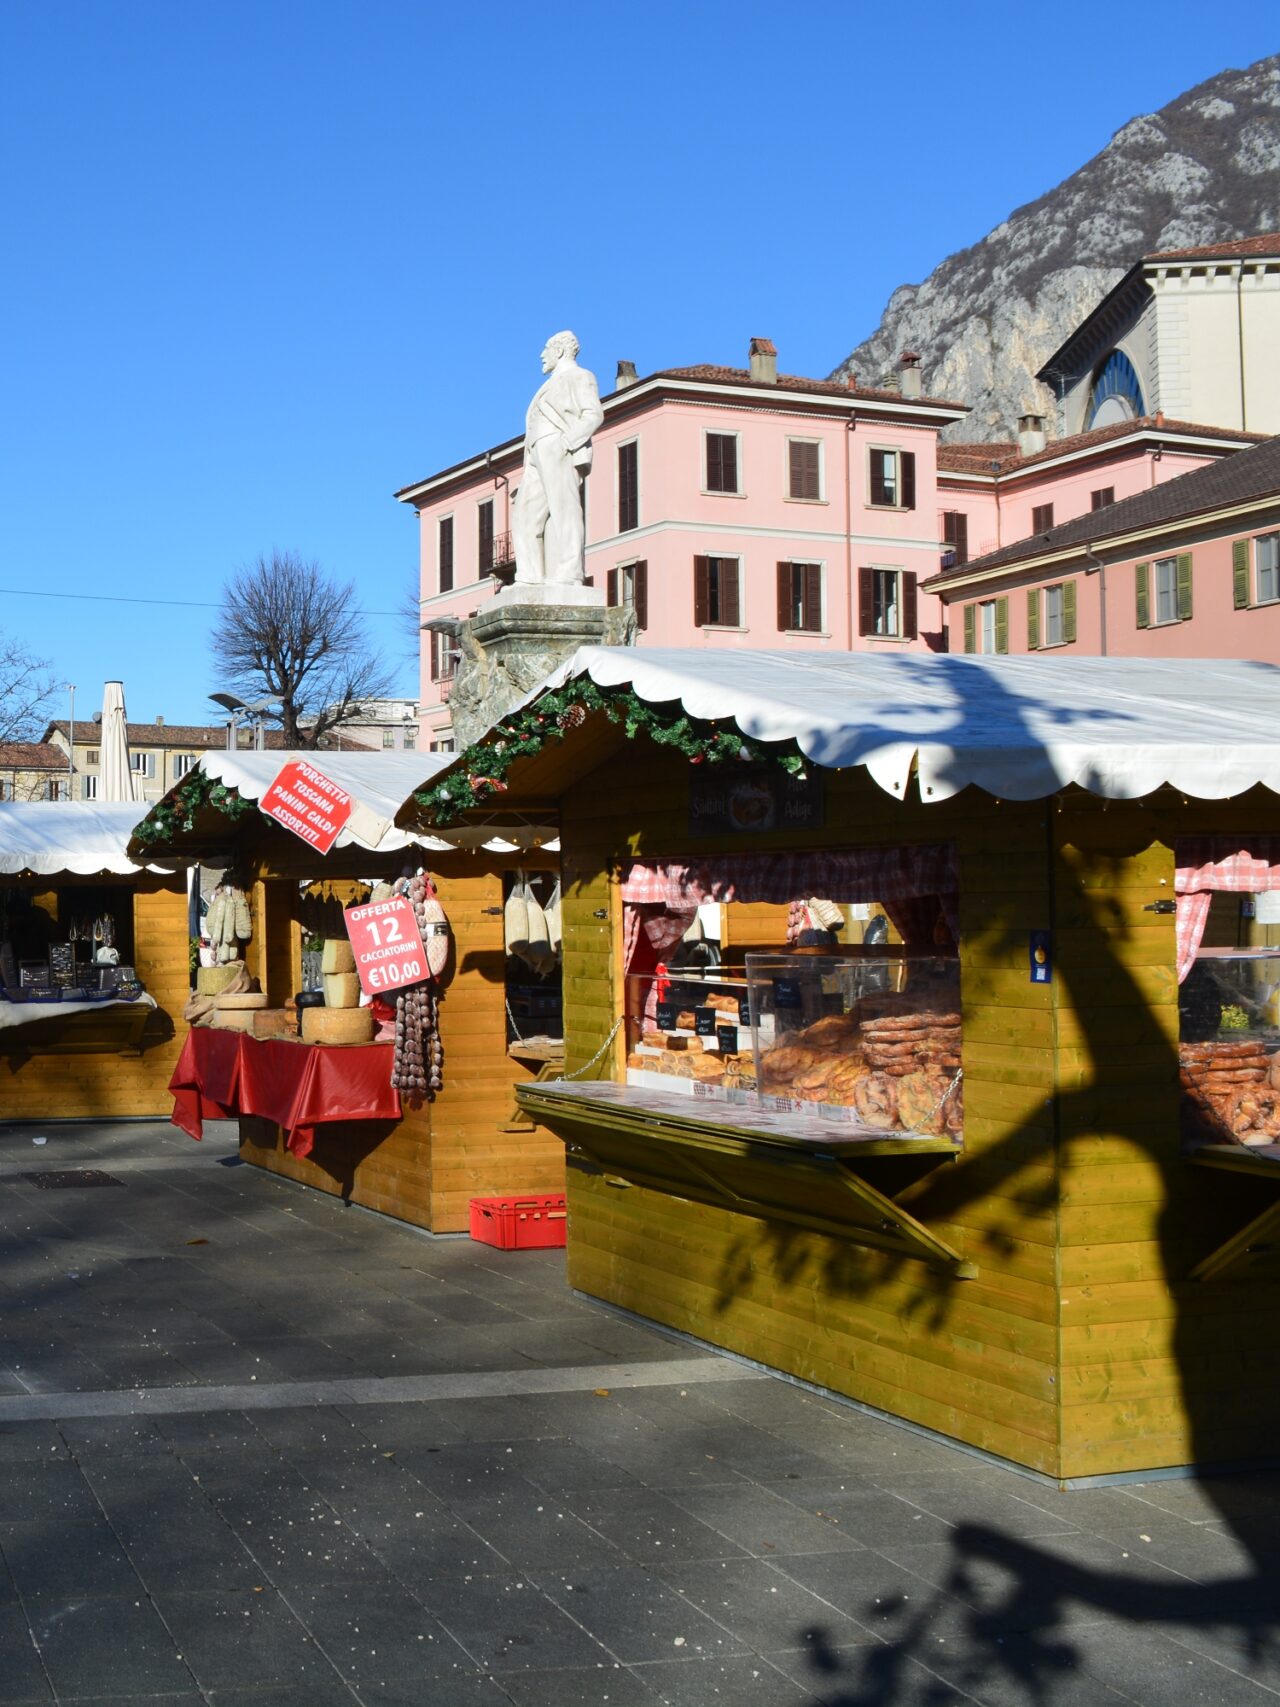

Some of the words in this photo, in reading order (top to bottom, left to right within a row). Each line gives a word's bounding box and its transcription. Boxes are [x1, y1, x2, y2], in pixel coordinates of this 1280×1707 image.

[293, 780, 334, 814] TOSCANA
[296, 762, 350, 805] PORCHETTA
[272, 785, 309, 815] PANINI
[306, 811, 336, 834] CALDI
[272, 805, 320, 843] ASSORTITI
[351, 900, 406, 921] OFFERTA
[366, 917, 403, 946] 12
[360, 941, 418, 963] CACCIATORINI
[368, 960, 421, 987] €10,00
